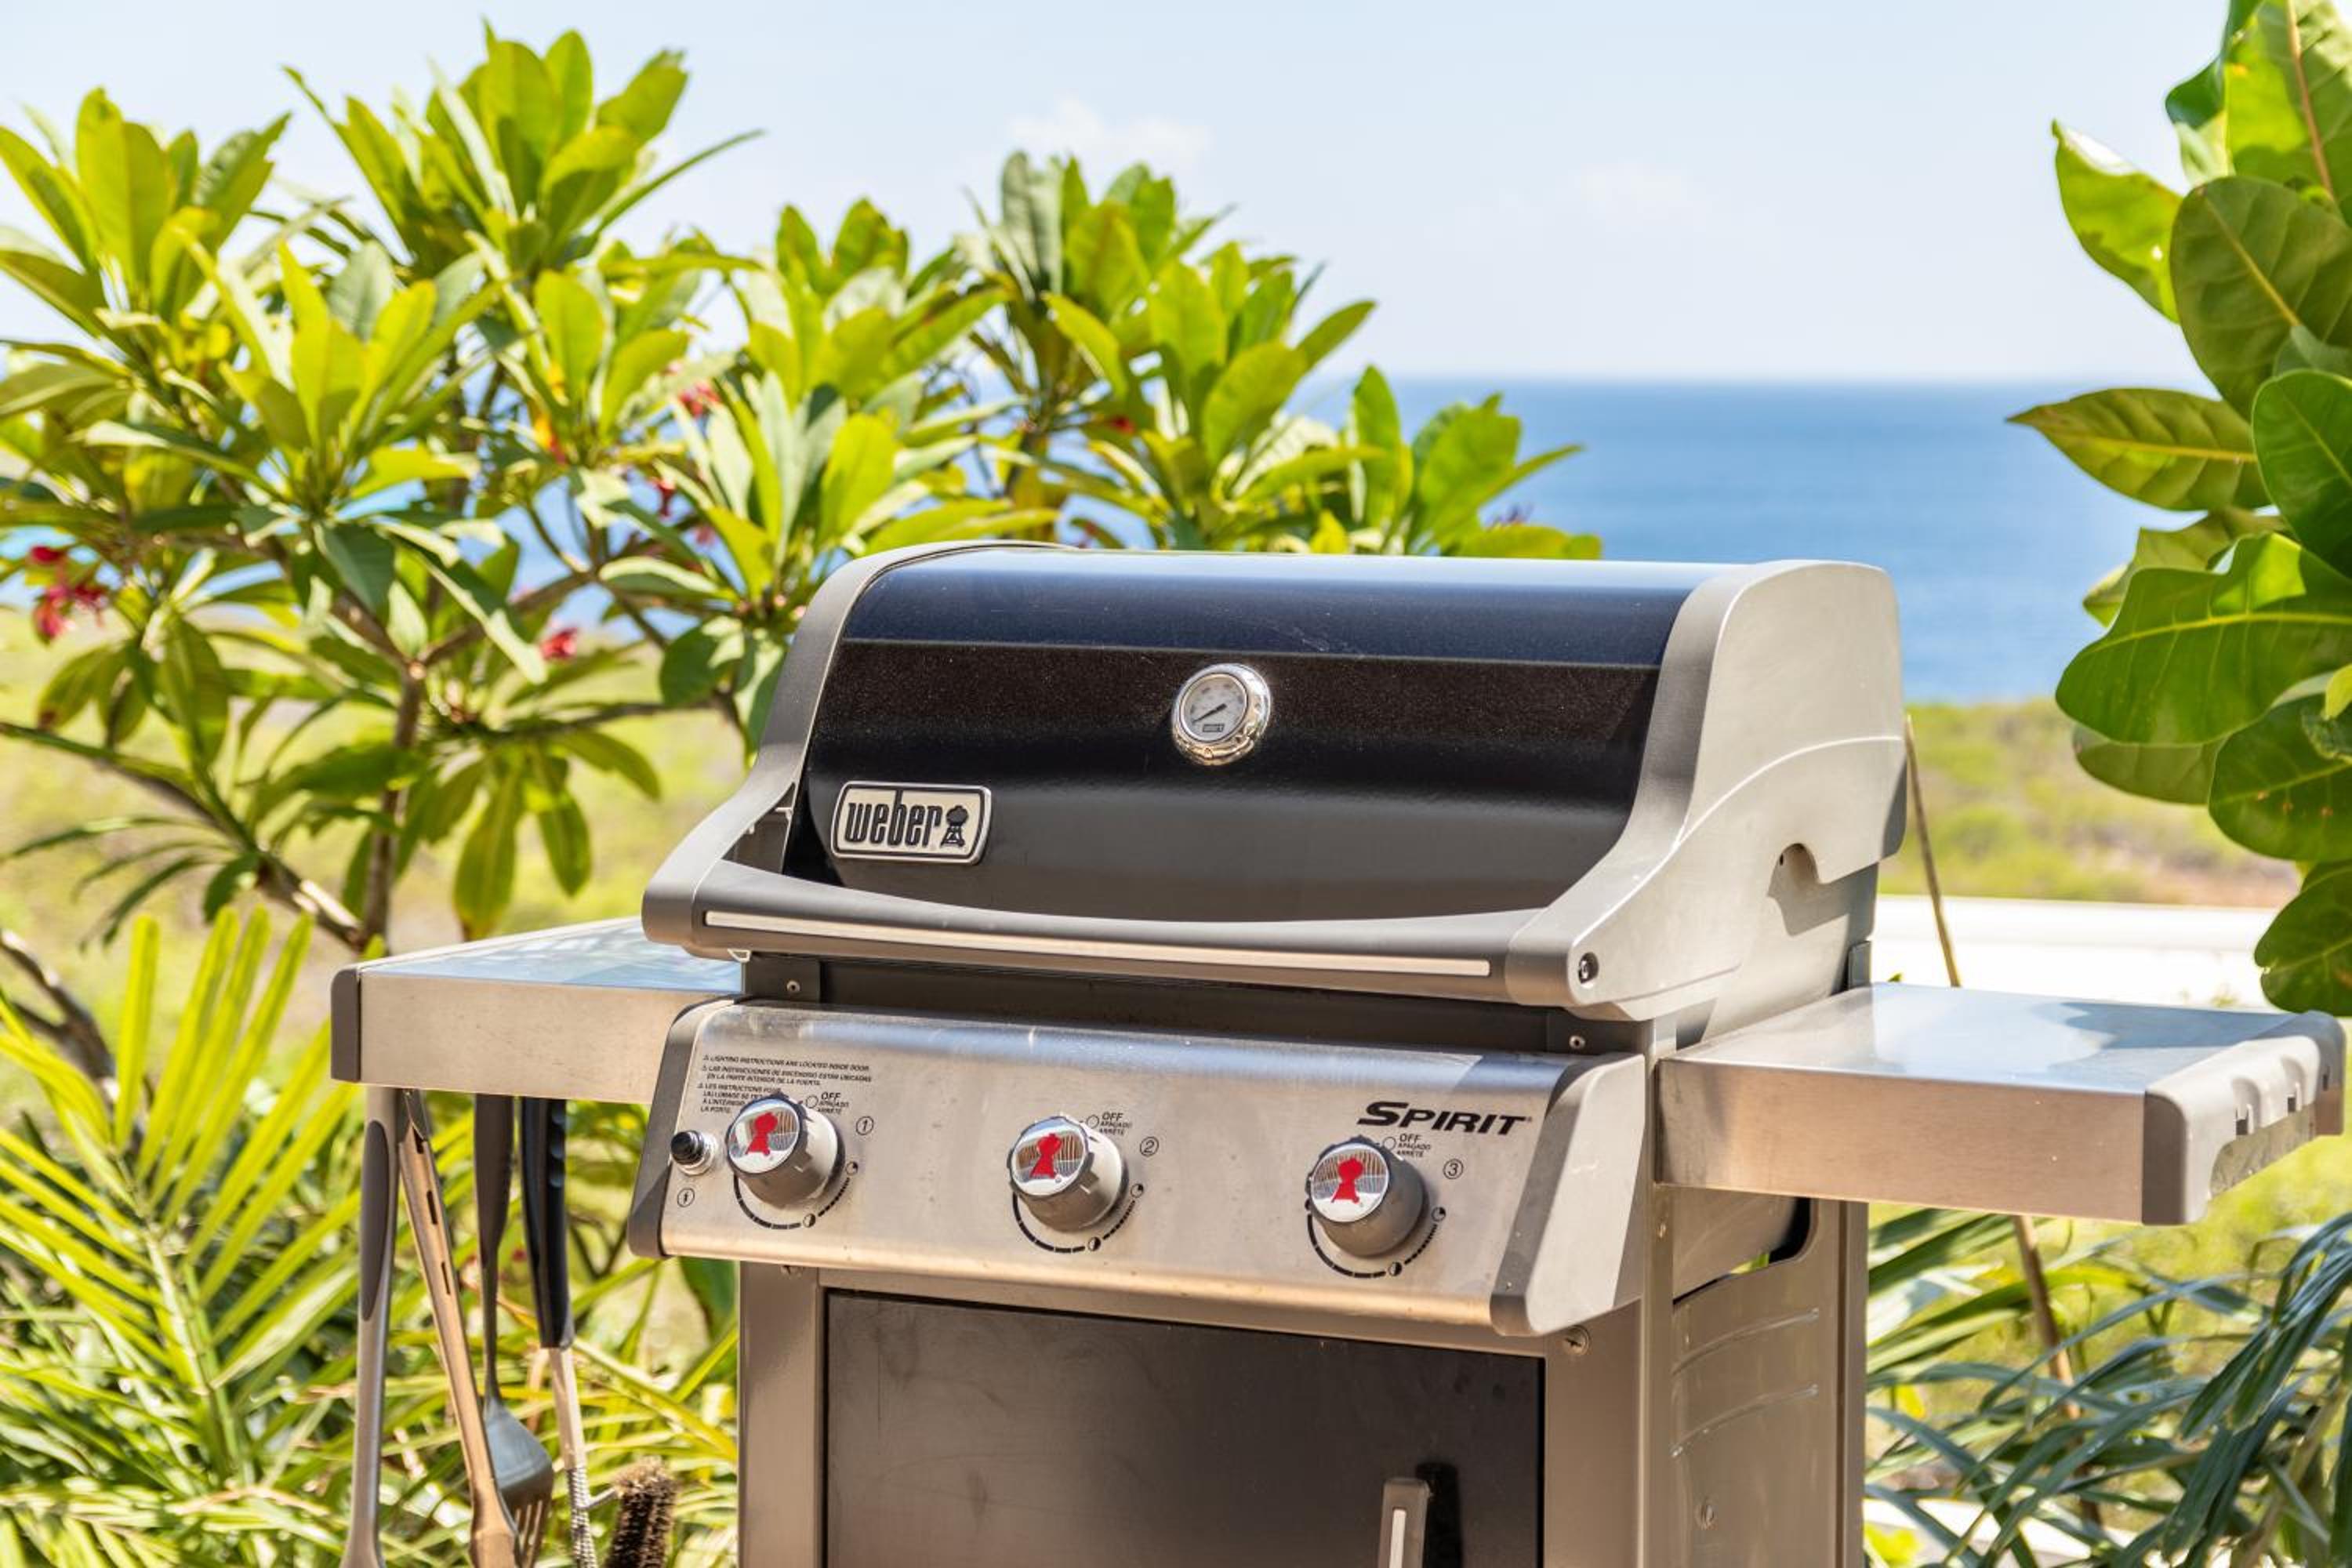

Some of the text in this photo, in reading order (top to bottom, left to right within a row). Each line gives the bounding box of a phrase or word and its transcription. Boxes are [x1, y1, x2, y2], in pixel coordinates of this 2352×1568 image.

[844, 789, 943, 848] weber
[821, 1091, 840, 1100] OFF
[1102, 1111, 1123, 1121] OFF
[1356, 1101, 1527, 1135] SPIRIT
[1399, 1133, 1422, 1144] OFF
